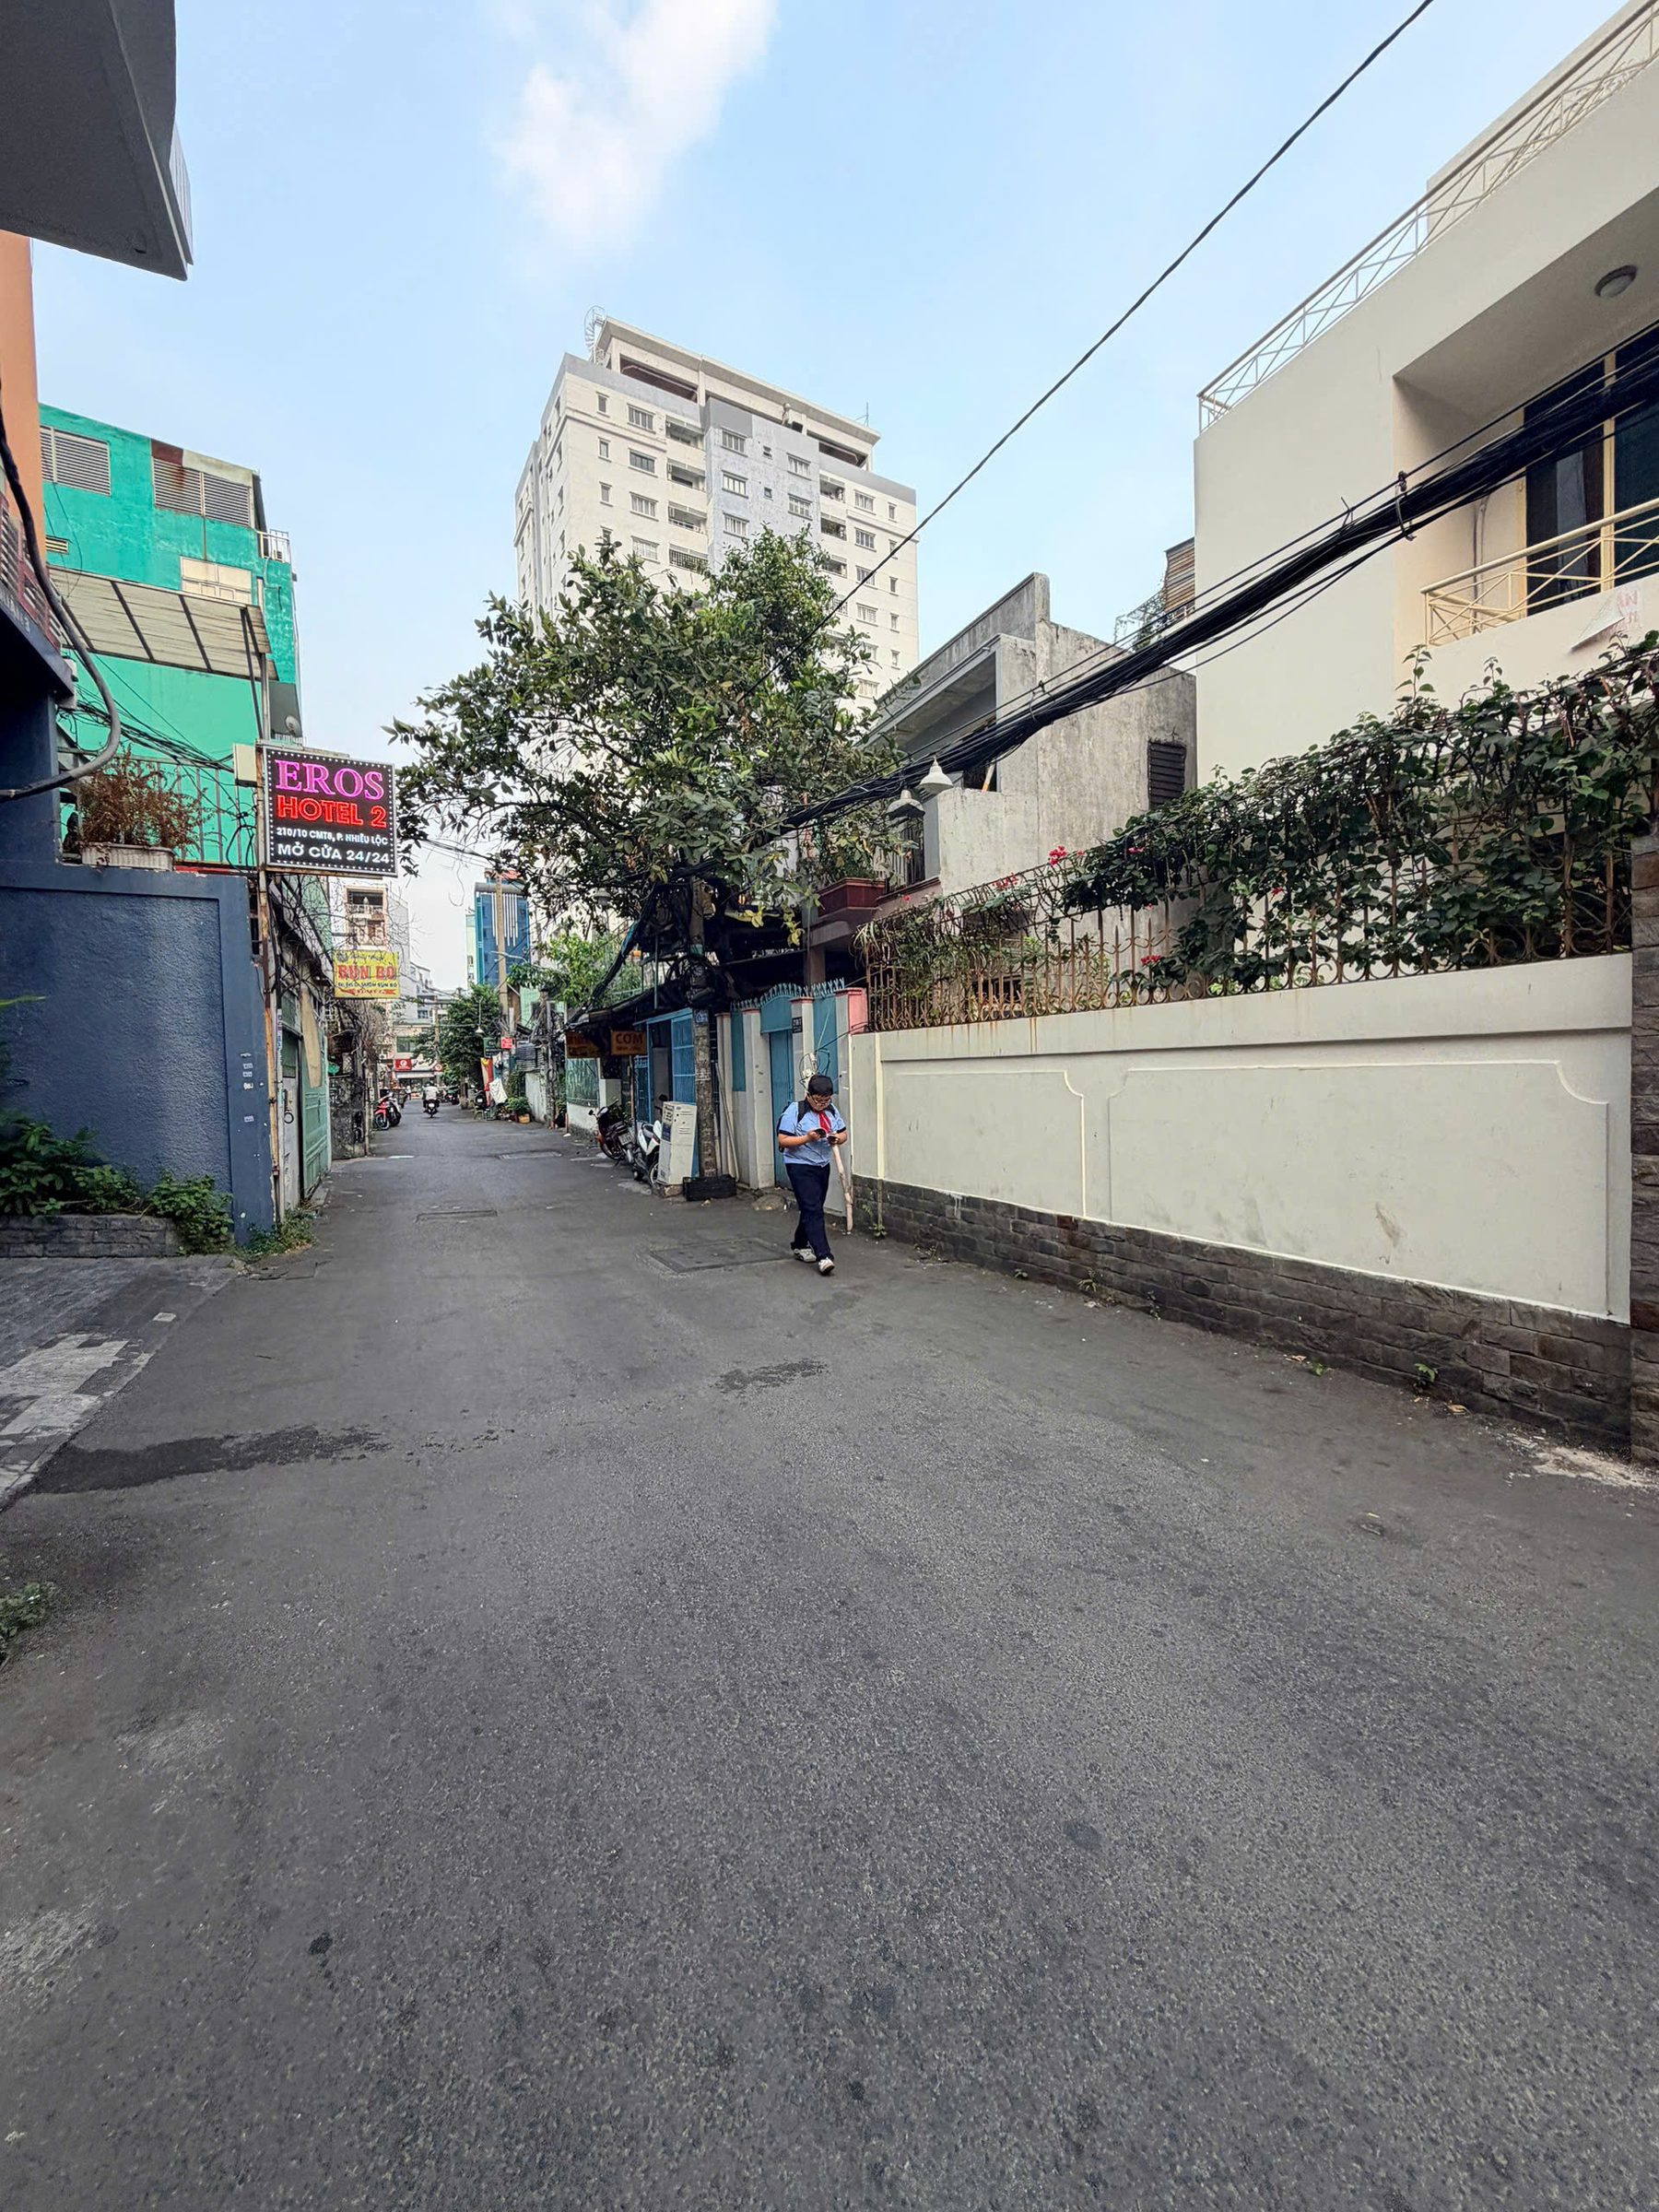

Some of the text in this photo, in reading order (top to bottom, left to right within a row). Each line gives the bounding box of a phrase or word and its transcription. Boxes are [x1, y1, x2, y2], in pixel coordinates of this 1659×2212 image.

[275, 759, 384, 800] EROS
[277, 795, 387, 829] HOTEL 2
[276, 827, 307, 838] 210/10
[336, 832, 344, 841] P.
[371, 834, 388, 846] LỘC
[277, 841, 390, 864] MỞ CỬA 24/24
